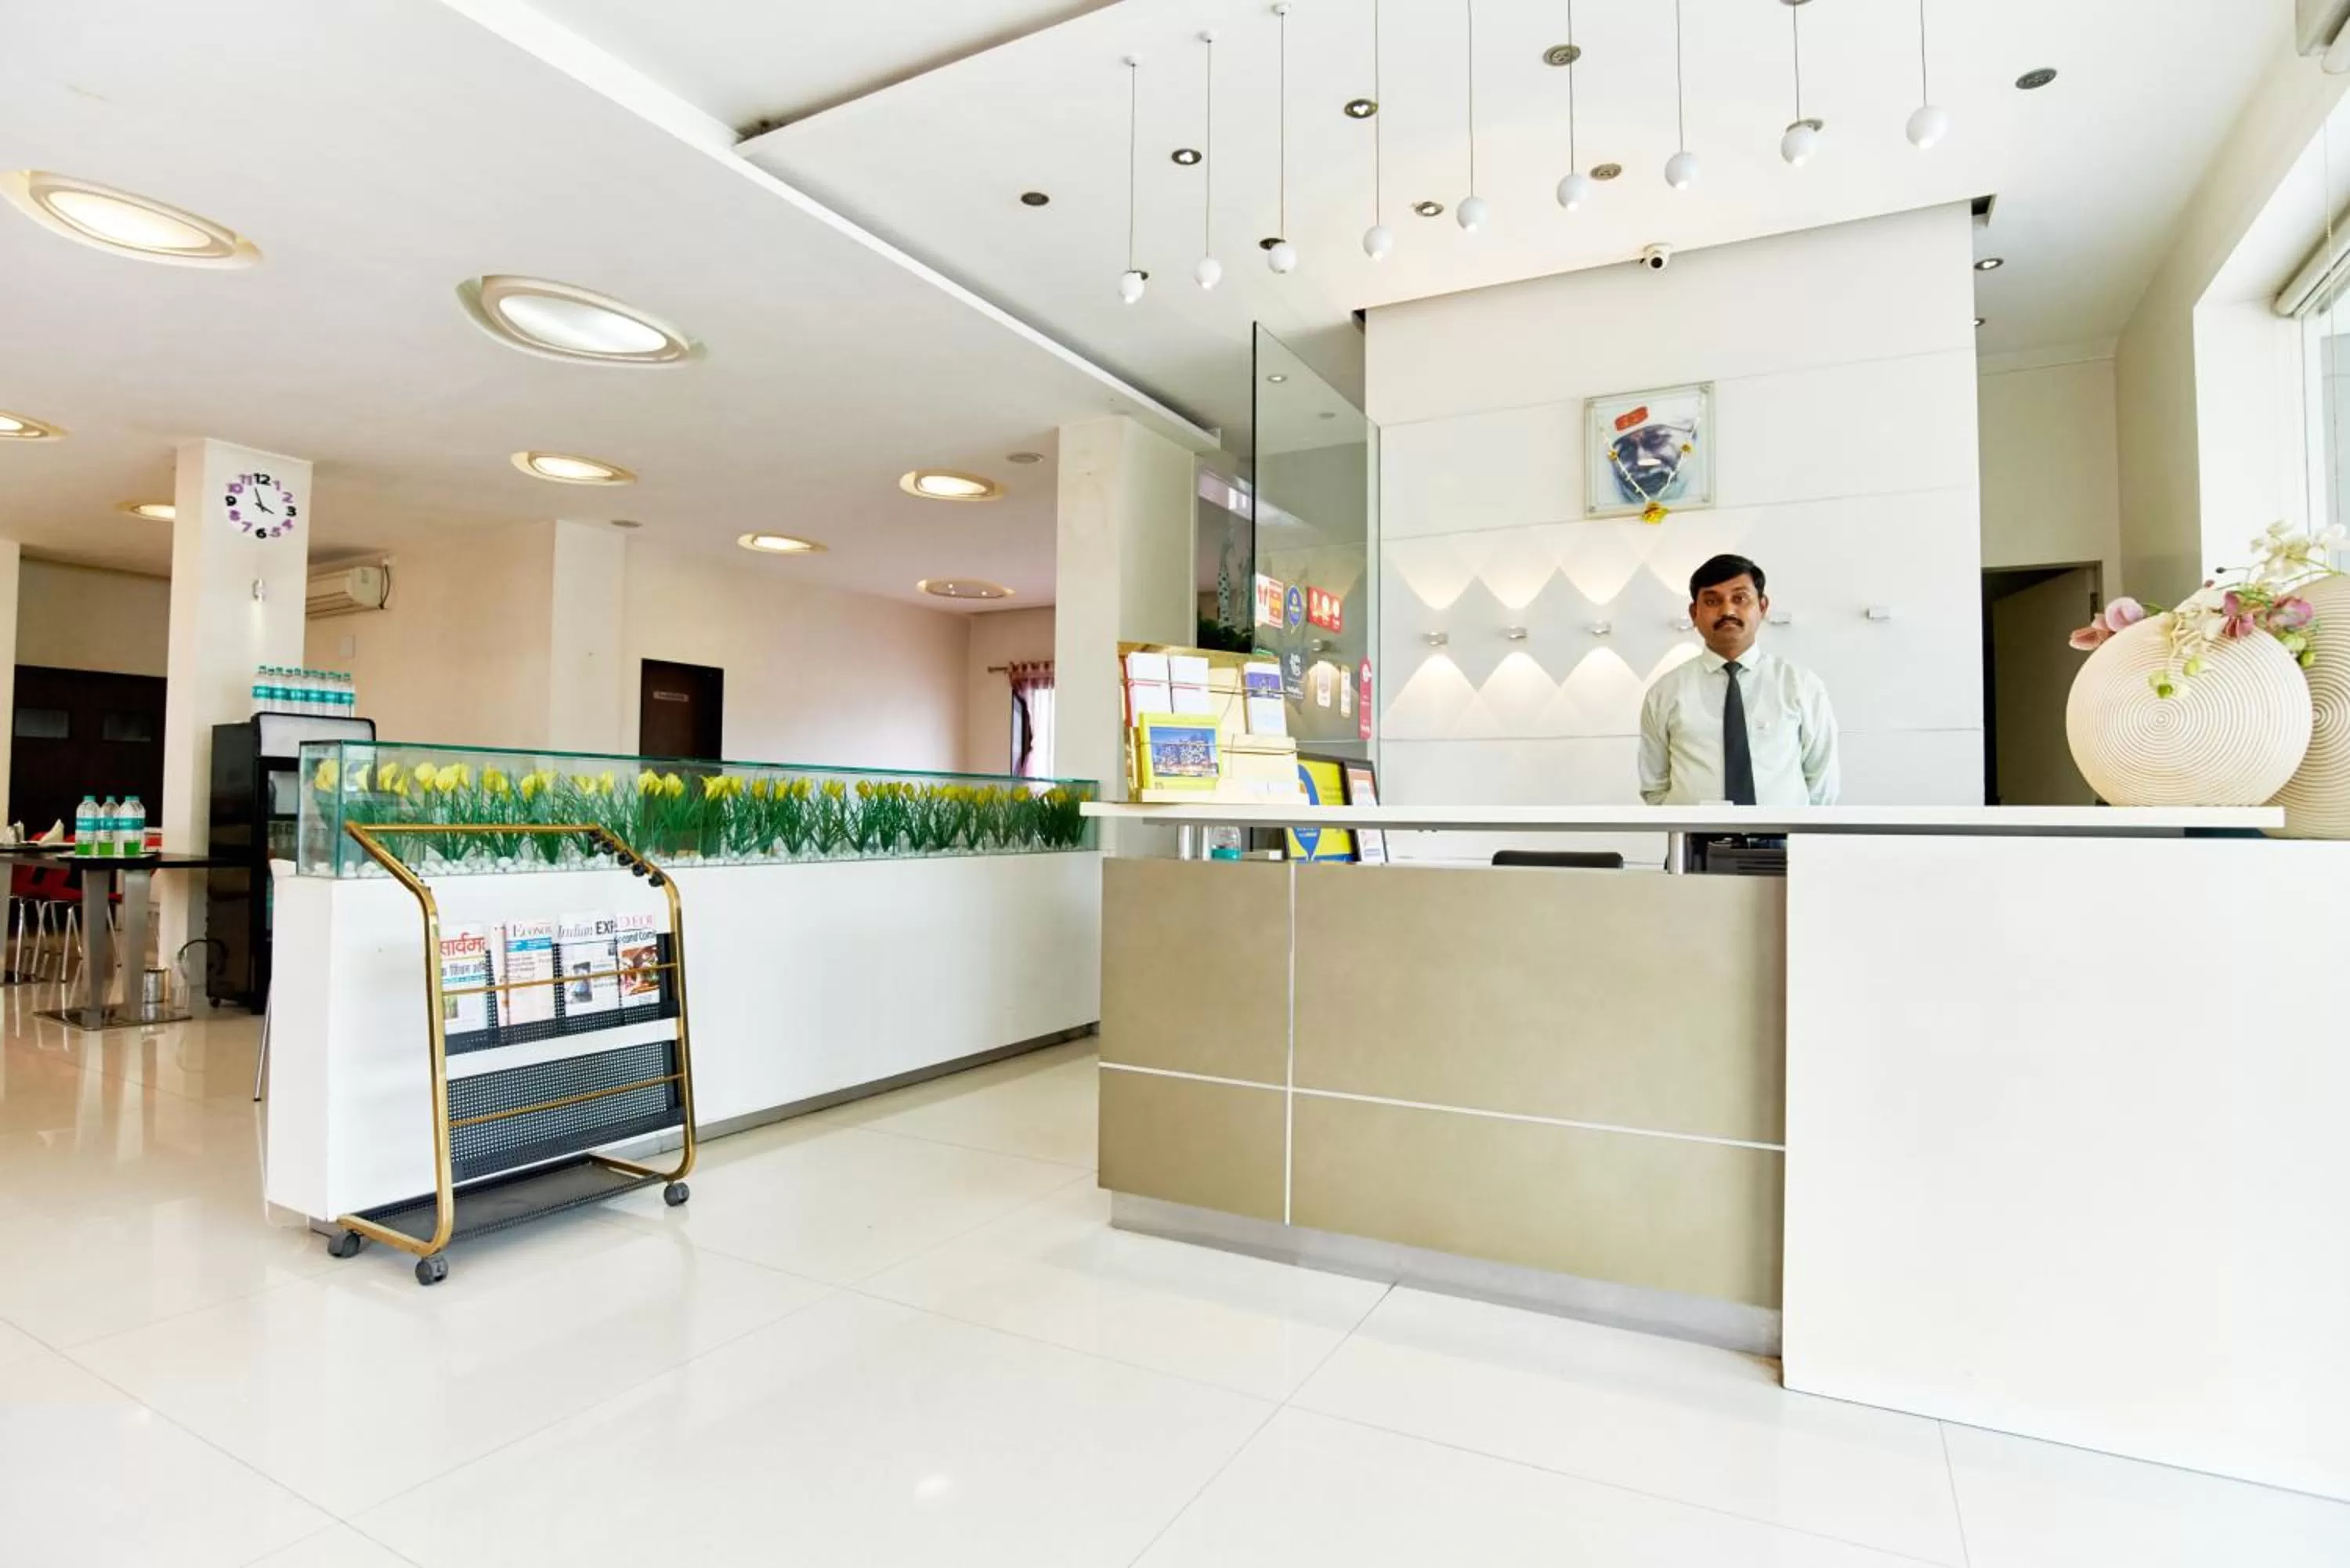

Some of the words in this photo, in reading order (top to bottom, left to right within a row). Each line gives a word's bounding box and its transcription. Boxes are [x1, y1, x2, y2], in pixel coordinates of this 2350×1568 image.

[253, 472, 271, 486] 12
[226, 482, 244, 494] 10
[273, 480, 280, 491] 1
[225, 495, 237, 507] 9
[282, 491, 293, 503] 2
[286, 505, 297, 517] 3
[241, 521, 252, 533] 7
[282, 518, 293, 530] 4
[255, 527, 266, 539] 6
[269, 526, 281, 537] 5
